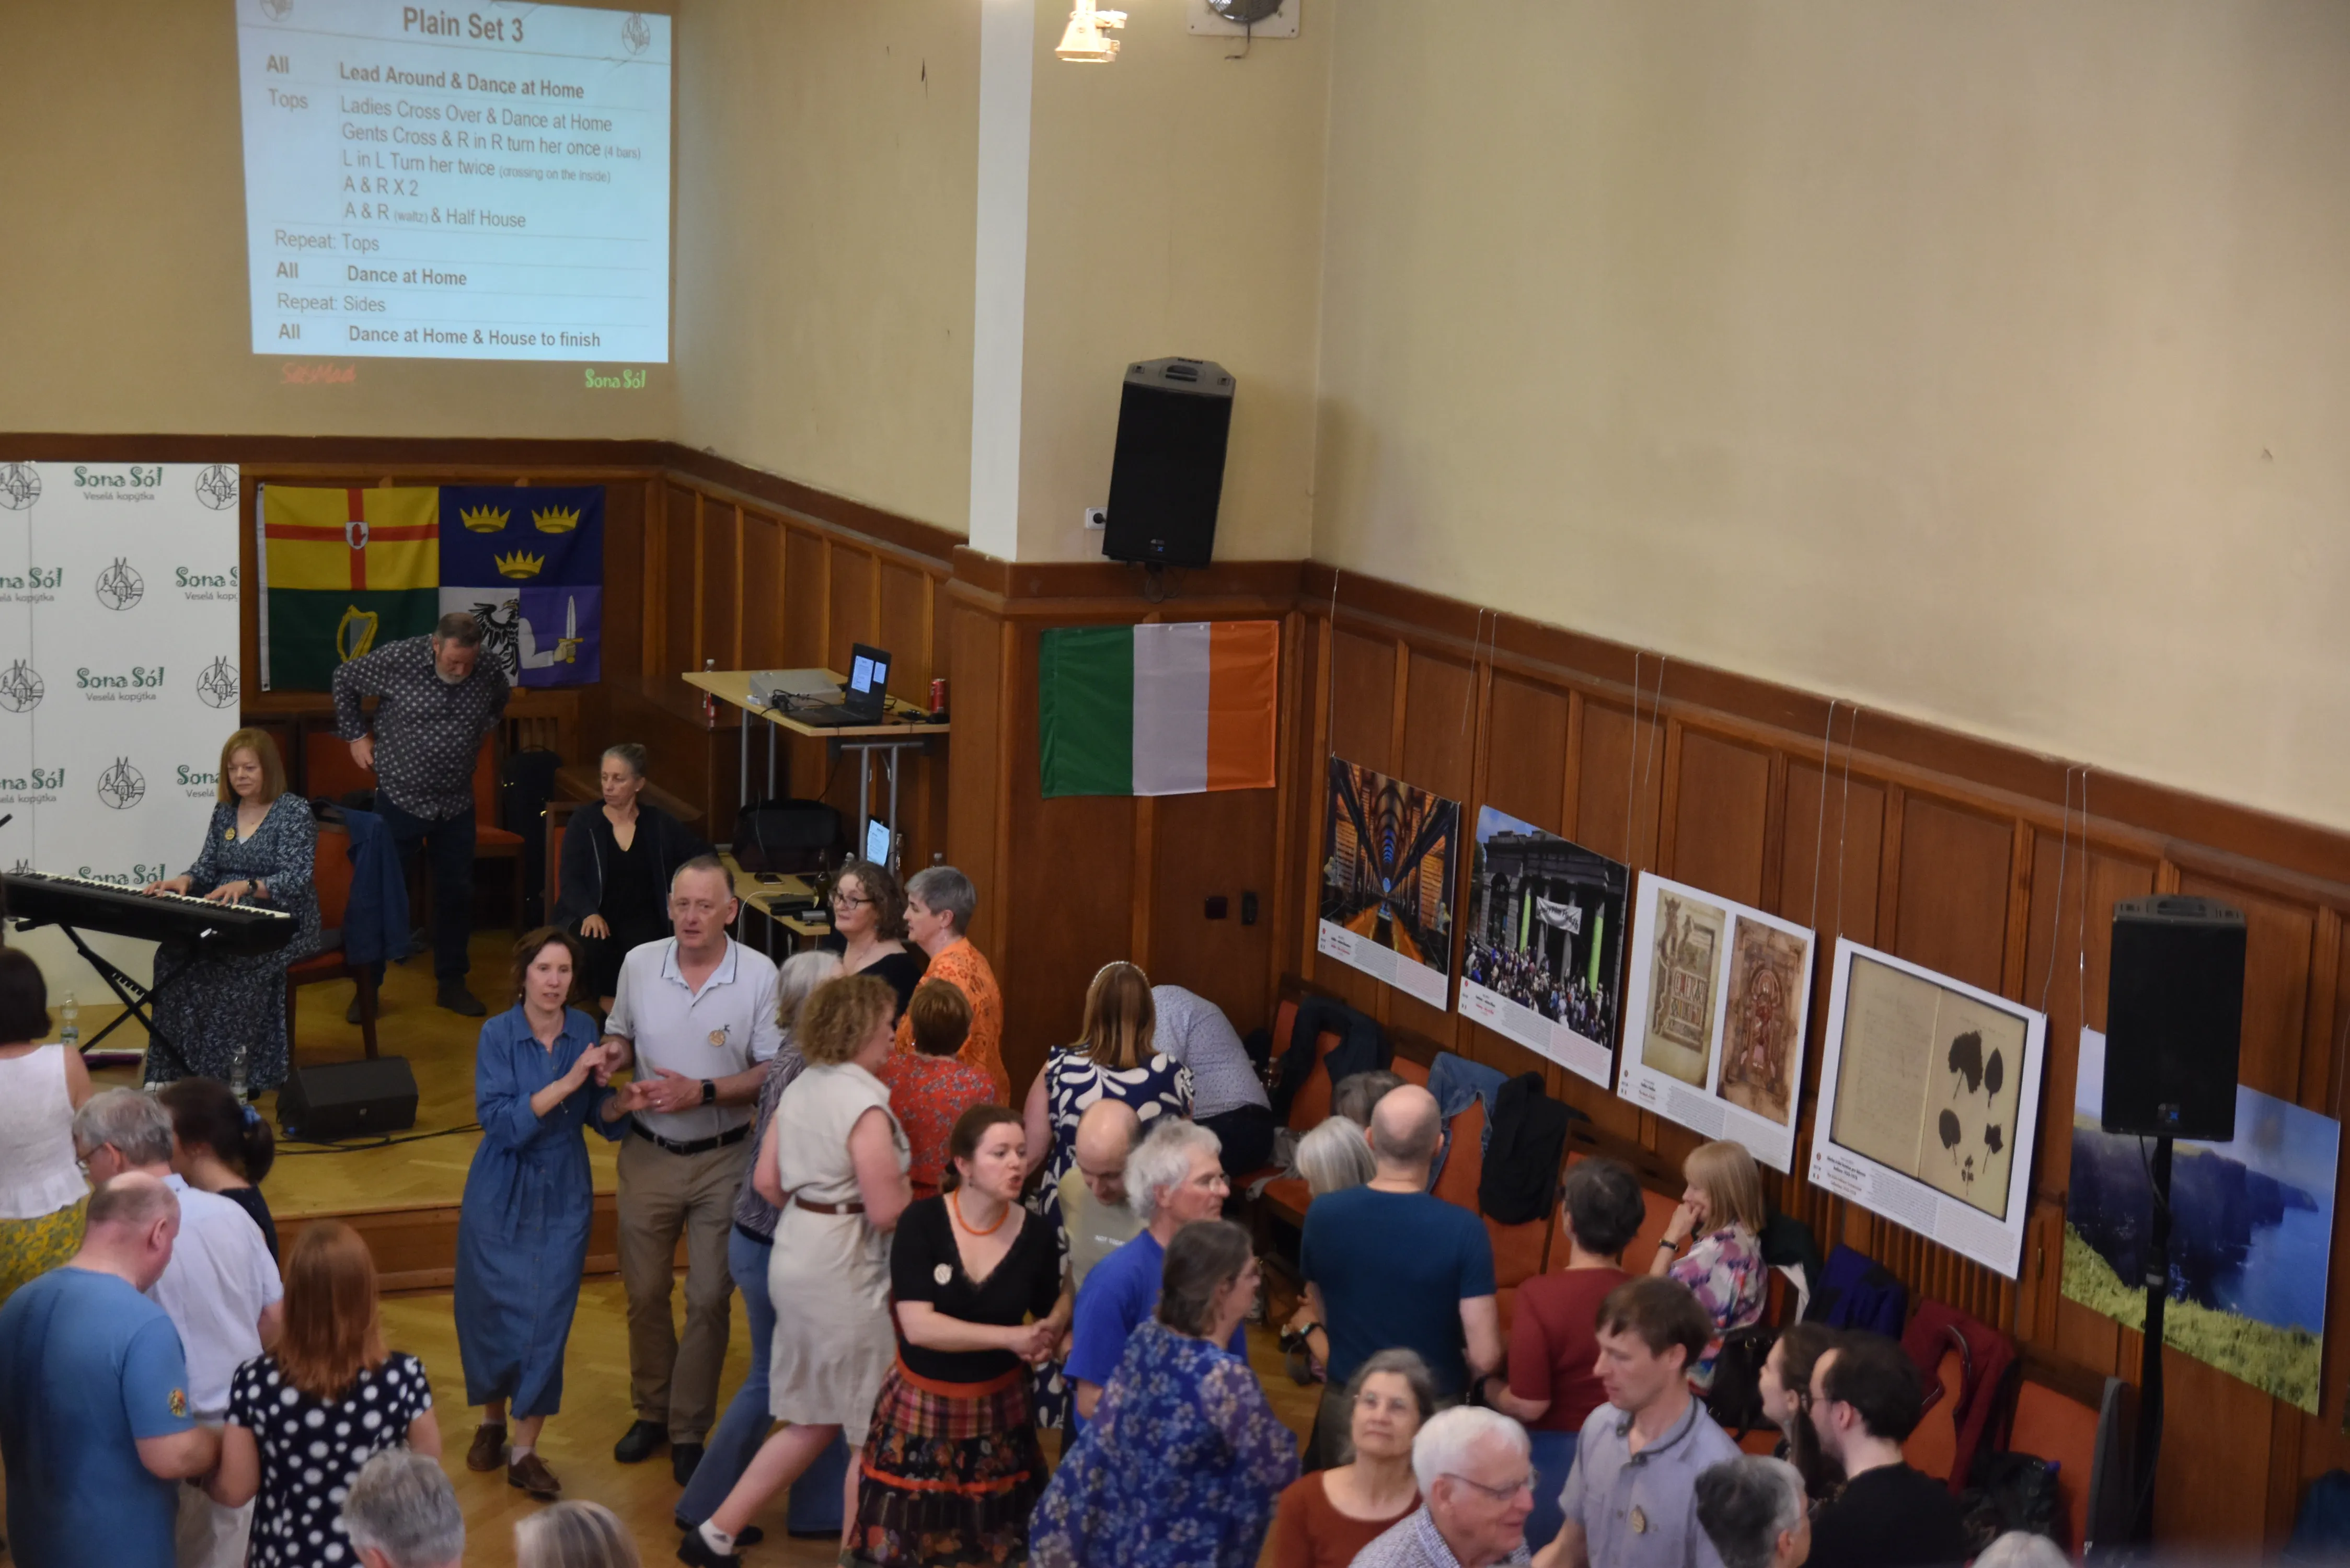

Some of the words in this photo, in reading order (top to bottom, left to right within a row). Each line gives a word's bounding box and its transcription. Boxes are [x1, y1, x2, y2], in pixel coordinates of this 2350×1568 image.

[403, 6, 460, 37] Plain
[468, 13, 504, 42] Set
[511, 17, 523, 43] 3
[266, 54, 290, 74] All
[340, 62, 380, 83] Lead
[386, 66, 446, 88] Around
[451, 72, 463, 89] &
[467, 73, 516, 94] Dance
[521, 80, 536, 95] at
[540, 79, 584, 99] Home
[268, 88, 308, 112] Tops
[341, 95, 392, 116] Ladies
[397, 100, 441, 120] Cross
[446, 104, 482, 123] Over
[487, 107, 497, 124] &
[502, 109, 548, 128] Dance
[553, 114, 566, 129] at
[571, 113, 612, 132] Home
[342, 122, 388, 143] Gents
[393, 126, 437, 146] Cross
[442, 131, 453, 147] &
[458, 131, 469, 148] R
[474, 133, 486, 149] in
[491, 133, 503, 151] R
[508, 136, 535, 152] turn
[540, 137, 562, 154] her
[567, 143, 601, 156] once
[617, 146, 641, 160] bars)
[343, 149, 352, 166] L
[358, 151, 371, 168] in
[376, 152, 385, 169] L
[390, 152, 424, 171] Turn
[430, 155, 454, 173] her
[458, 158, 495, 176] twice
[546, 168, 559, 179] on
[561, 169, 576, 181] the
[344, 176, 355, 193] A
[361, 176, 371, 193] &
[377, 177, 388, 194] R
[394, 178, 405, 195] X
[409, 180, 419, 197] 2
[344, 201, 356, 218] A
[361, 202, 372, 220] &
[378, 203, 389, 221] R
[431, 207, 442, 224] &
[447, 208, 476, 226] Half
[480, 210, 526, 227] House
[274, 229, 336, 251] Repeat:
[342, 233, 379, 255] Tops
[276, 261, 298, 279] All
[348, 265, 398, 283] Dance
[402, 268, 418, 284] at
[422, 268, 467, 285] Home
[278, 292, 338, 313] Repeat:
[343, 295, 386, 312] Sides
[279, 323, 300, 340] All
[349, 325, 399, 342] Dance
[404, 328, 419, 343] at
[423, 328, 468, 344] Home
[473, 329, 484, 345] &
[489, 330, 536, 345] House
[541, 331, 556, 346] to
[560, 331, 601, 347] finish
[584, 368, 621, 388] Sona
[623, 369, 646, 389] Sól
[74, 466, 126, 487] Sona
[130, 466, 163, 487] Sól
[83, 491, 113, 500] Veselá
[117, 491, 155, 503] kopýtka
[29, 567, 63, 589] Sól
[176, 566, 226, 587] Sona
[185, 591, 214, 600] Veselá
[77, 667, 128, 688] Sona
[132, 667, 164, 688] Sól
[86, 692, 116, 701] Veselá
[119, 691, 157, 702] kopýtka
[32, 768, 65, 789] Sól
[186, 788, 215, 798] Veselá
[133, 863, 166, 884] Sól
